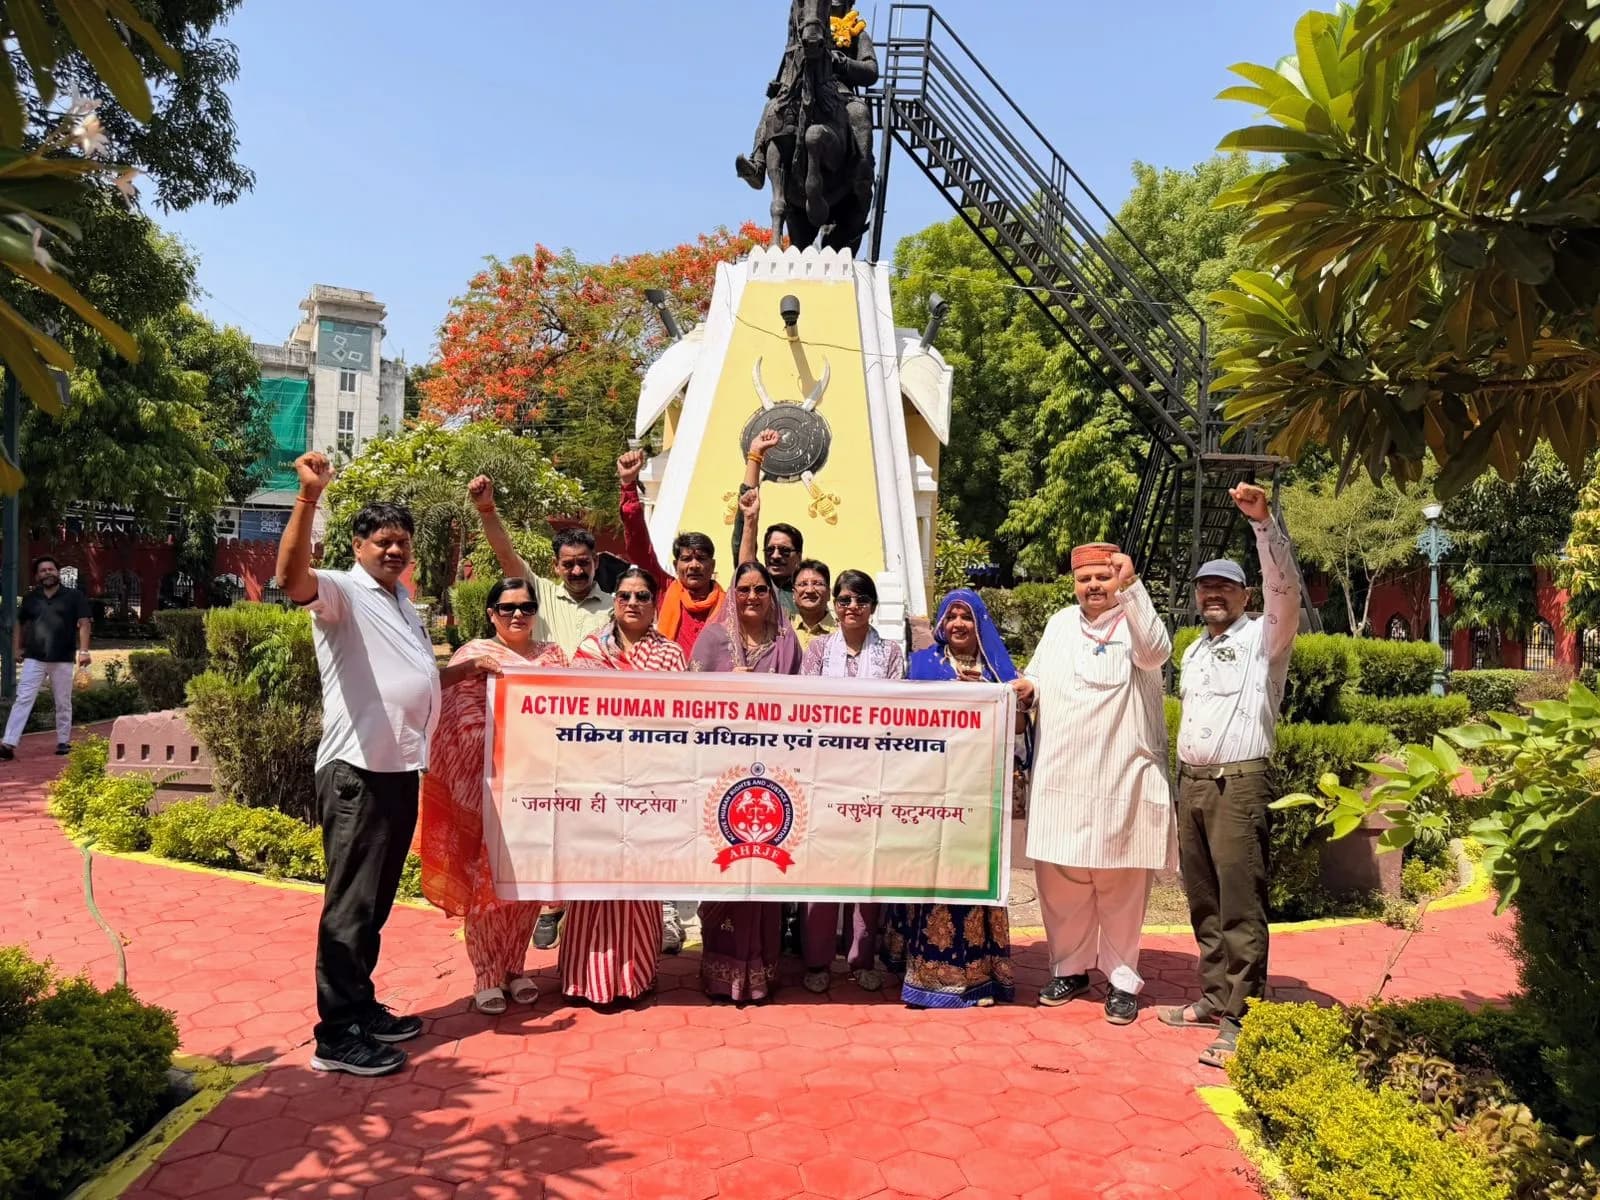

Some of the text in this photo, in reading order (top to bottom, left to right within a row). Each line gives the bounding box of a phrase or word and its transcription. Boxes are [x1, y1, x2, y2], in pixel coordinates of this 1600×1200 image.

[521, 695, 982, 729] ACTIVE HUMAN RIGHTS AND JUSTICE FOUNDATION
[556, 722, 947, 753] सक्रिय मानव अधिकार एवं न्याय संस्थान
[590, 792, 608, 813] ही
[720, 795, 732, 819] HUMAN
[766, 781, 788, 802] JUSTICE
